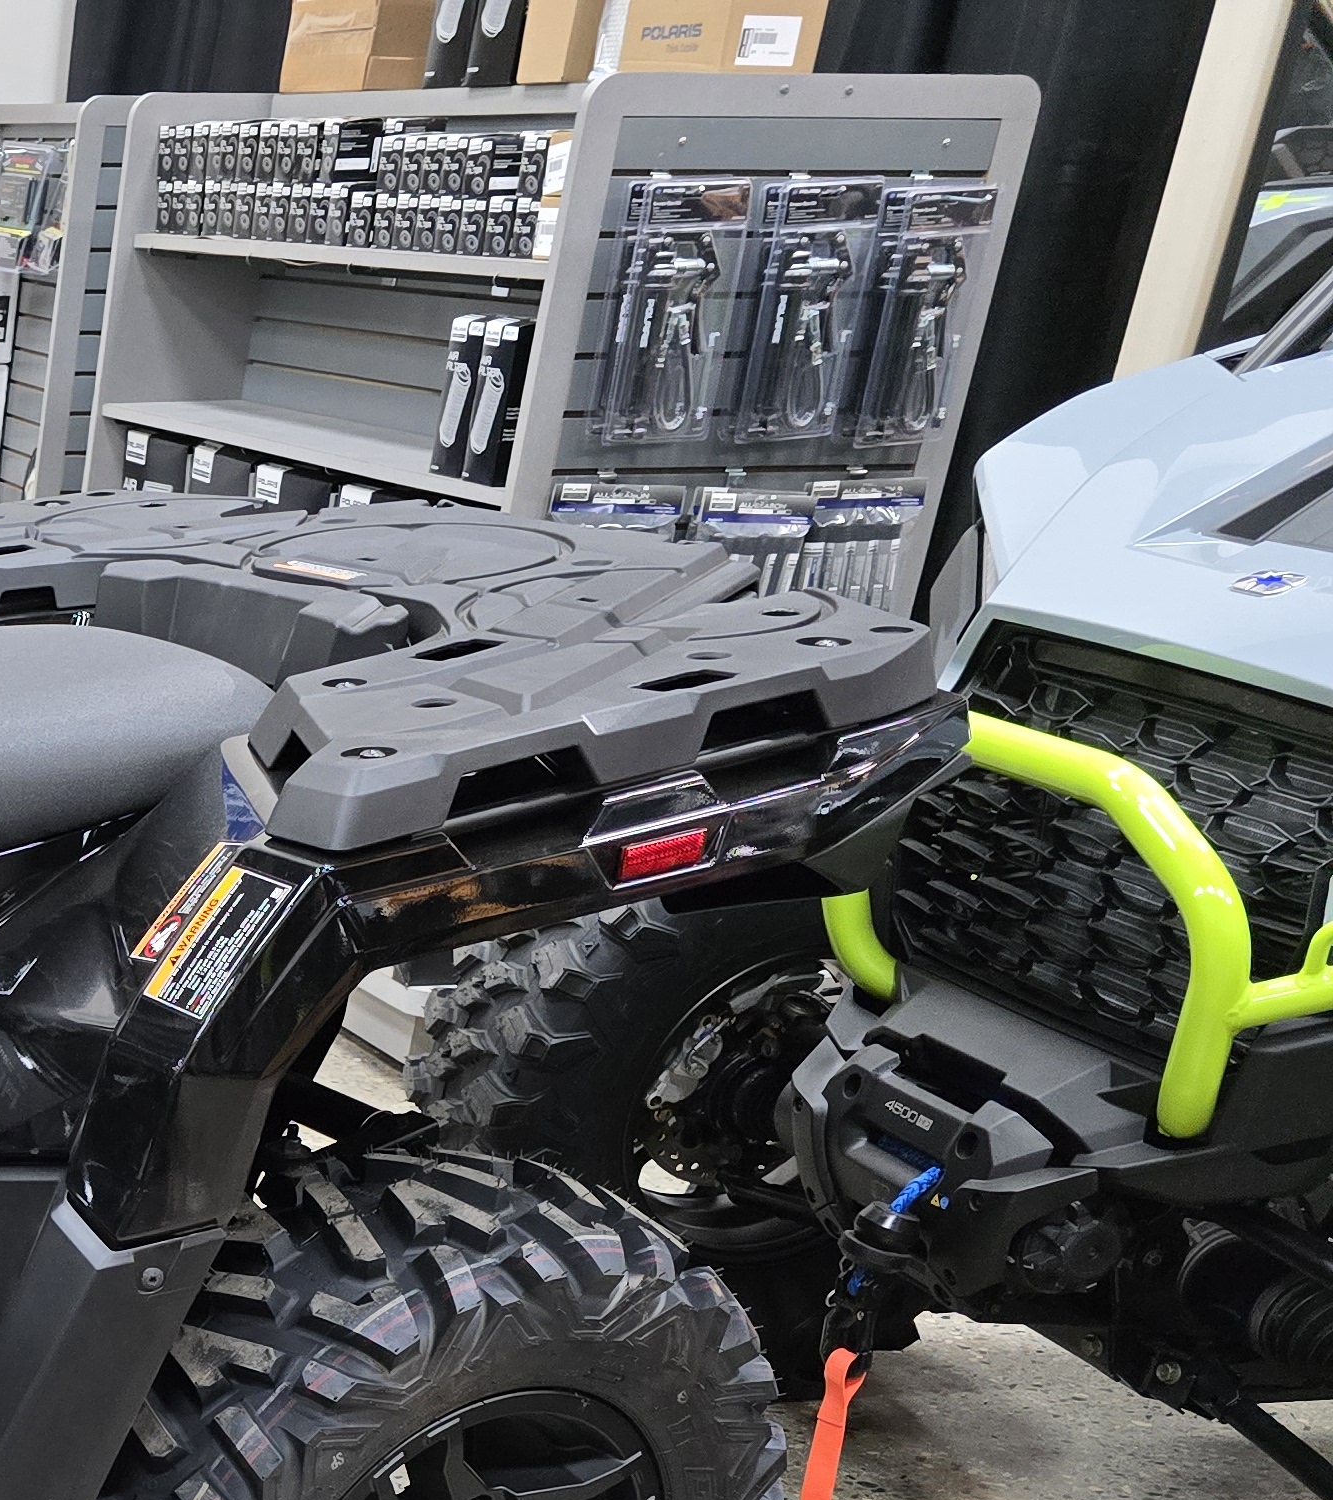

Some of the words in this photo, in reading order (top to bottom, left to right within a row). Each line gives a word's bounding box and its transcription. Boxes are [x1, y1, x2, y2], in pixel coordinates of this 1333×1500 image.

[641, 23, 703, 41] POLARIS
[176, 897, 220, 952] WARNING
[885, 1100, 919, 1124] 4500
